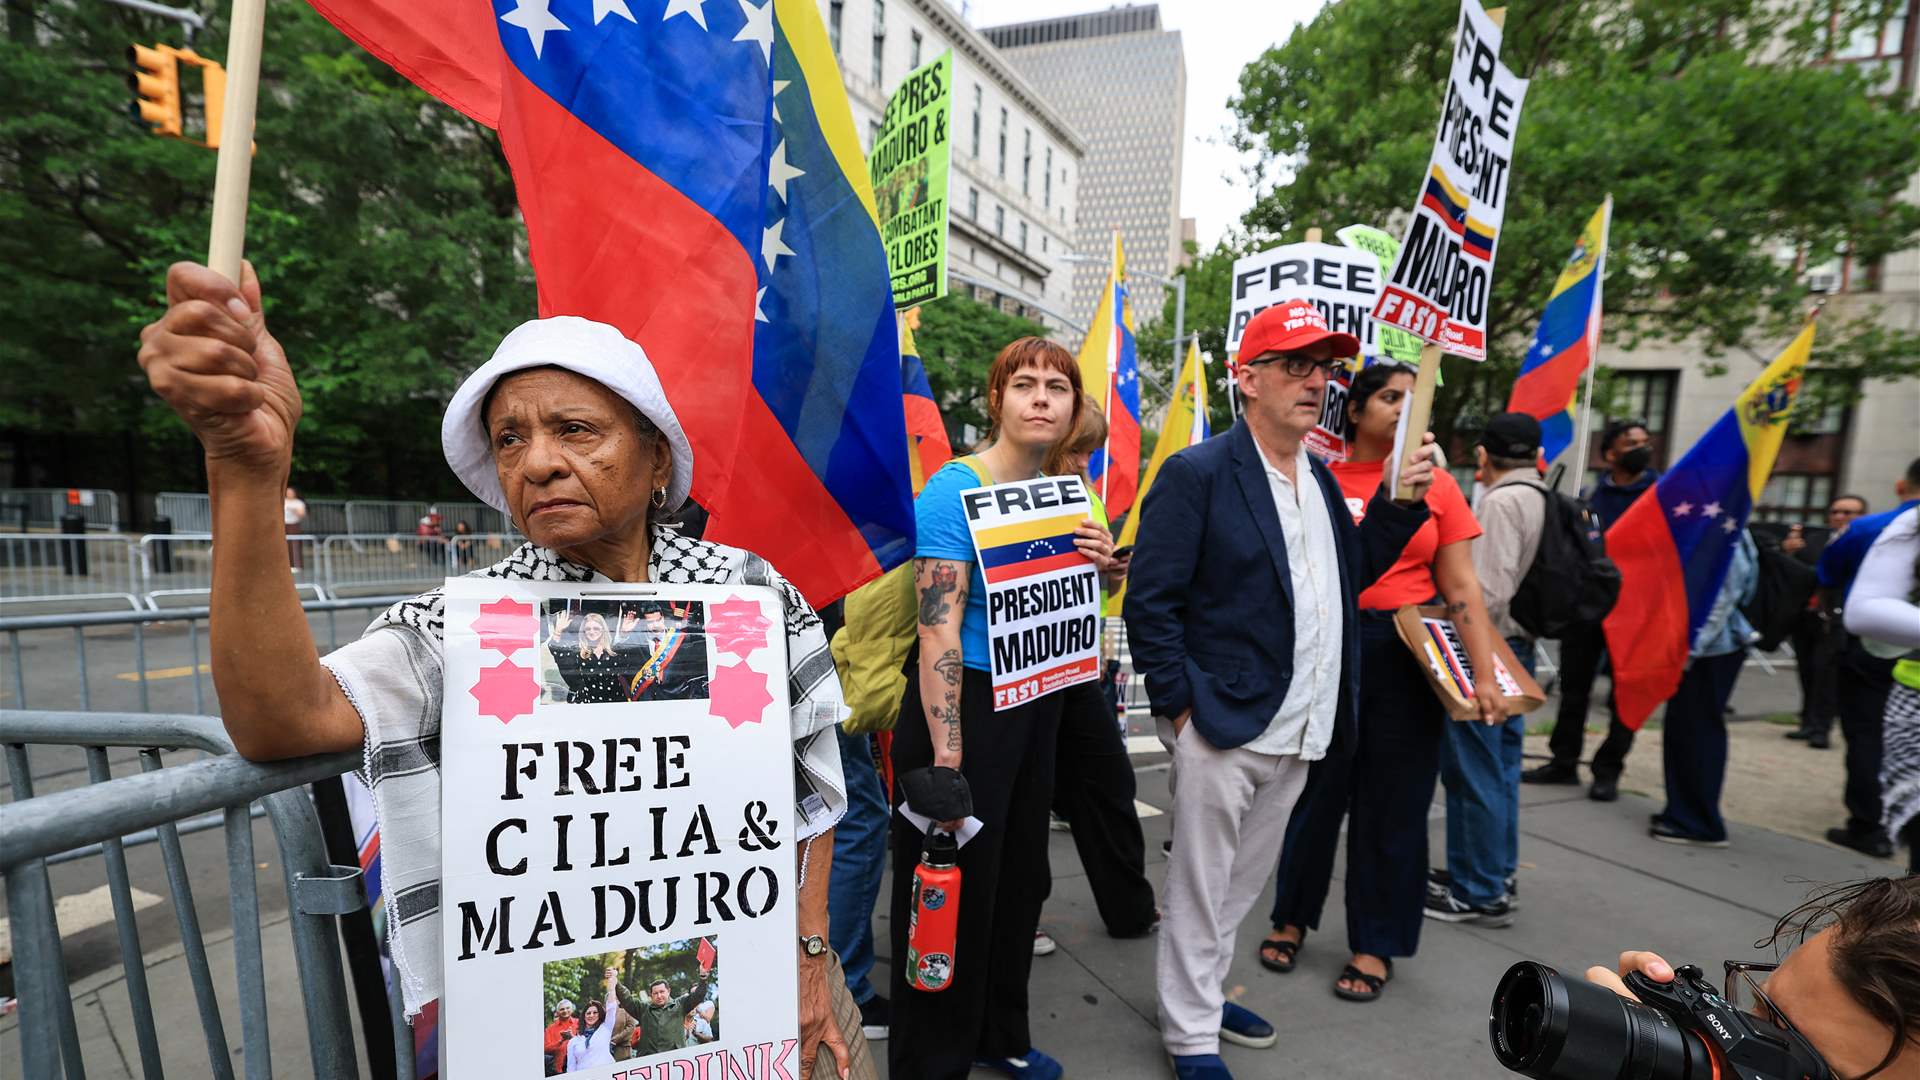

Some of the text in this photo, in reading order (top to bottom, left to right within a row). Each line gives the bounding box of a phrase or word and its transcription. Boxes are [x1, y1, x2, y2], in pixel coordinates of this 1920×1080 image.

[899, 61, 947, 123] PRES.
[934, 108, 946, 146] &
[890, 227, 938, 273] FLORES
[1236, 257, 1376, 300] FREE
[964, 480, 1087, 521] FREE
[989, 571, 1096, 626] PRESIDENT
[993, 613, 1096, 676] MADURO
[501, 735, 692, 801] FREE
[485, 800, 782, 876] CILIA &
[457, 866, 780, 961] MADURO
[1706, 1013, 1732, 1040] SONY
[612, 1038, 798, 1080] PINK
